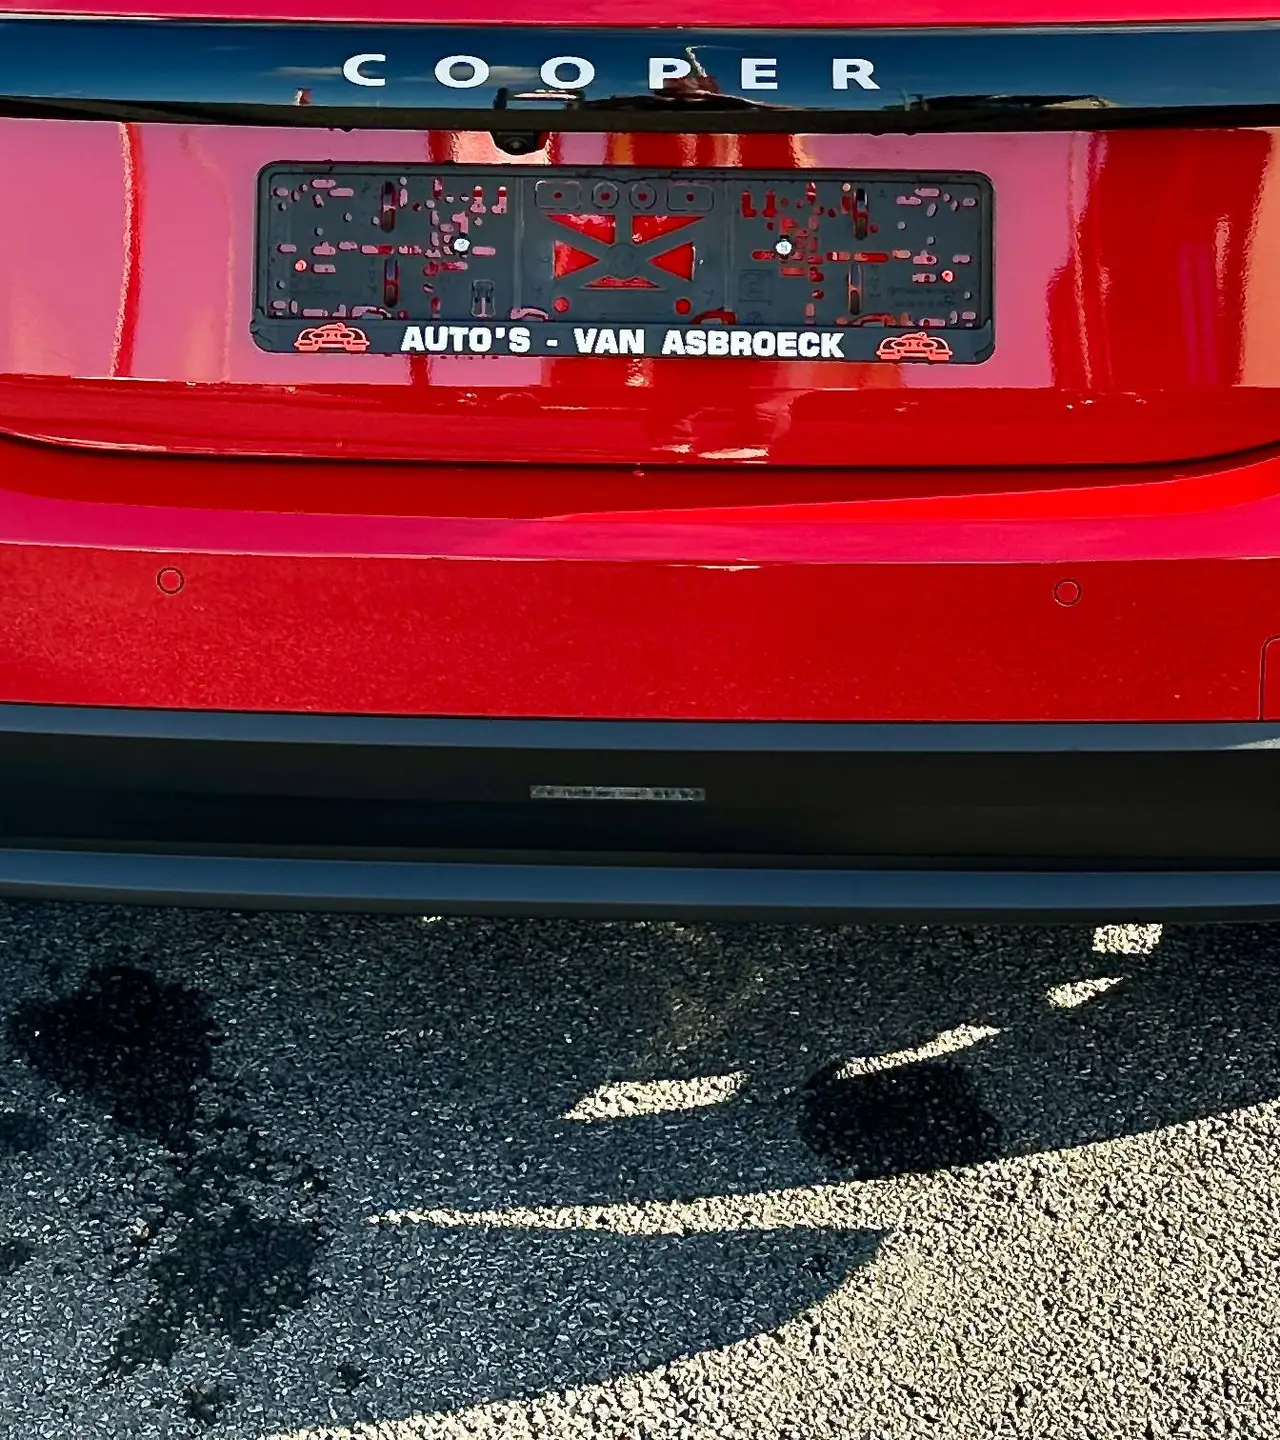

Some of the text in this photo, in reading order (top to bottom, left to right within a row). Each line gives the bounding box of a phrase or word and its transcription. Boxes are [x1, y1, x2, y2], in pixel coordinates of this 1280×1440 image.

[342, 54, 881, 90] COOPER
[400, 326, 531, 354] AUTO'S
[573, 327, 645, 355] VAN
[661, 329, 845, 359] ASBROECK
